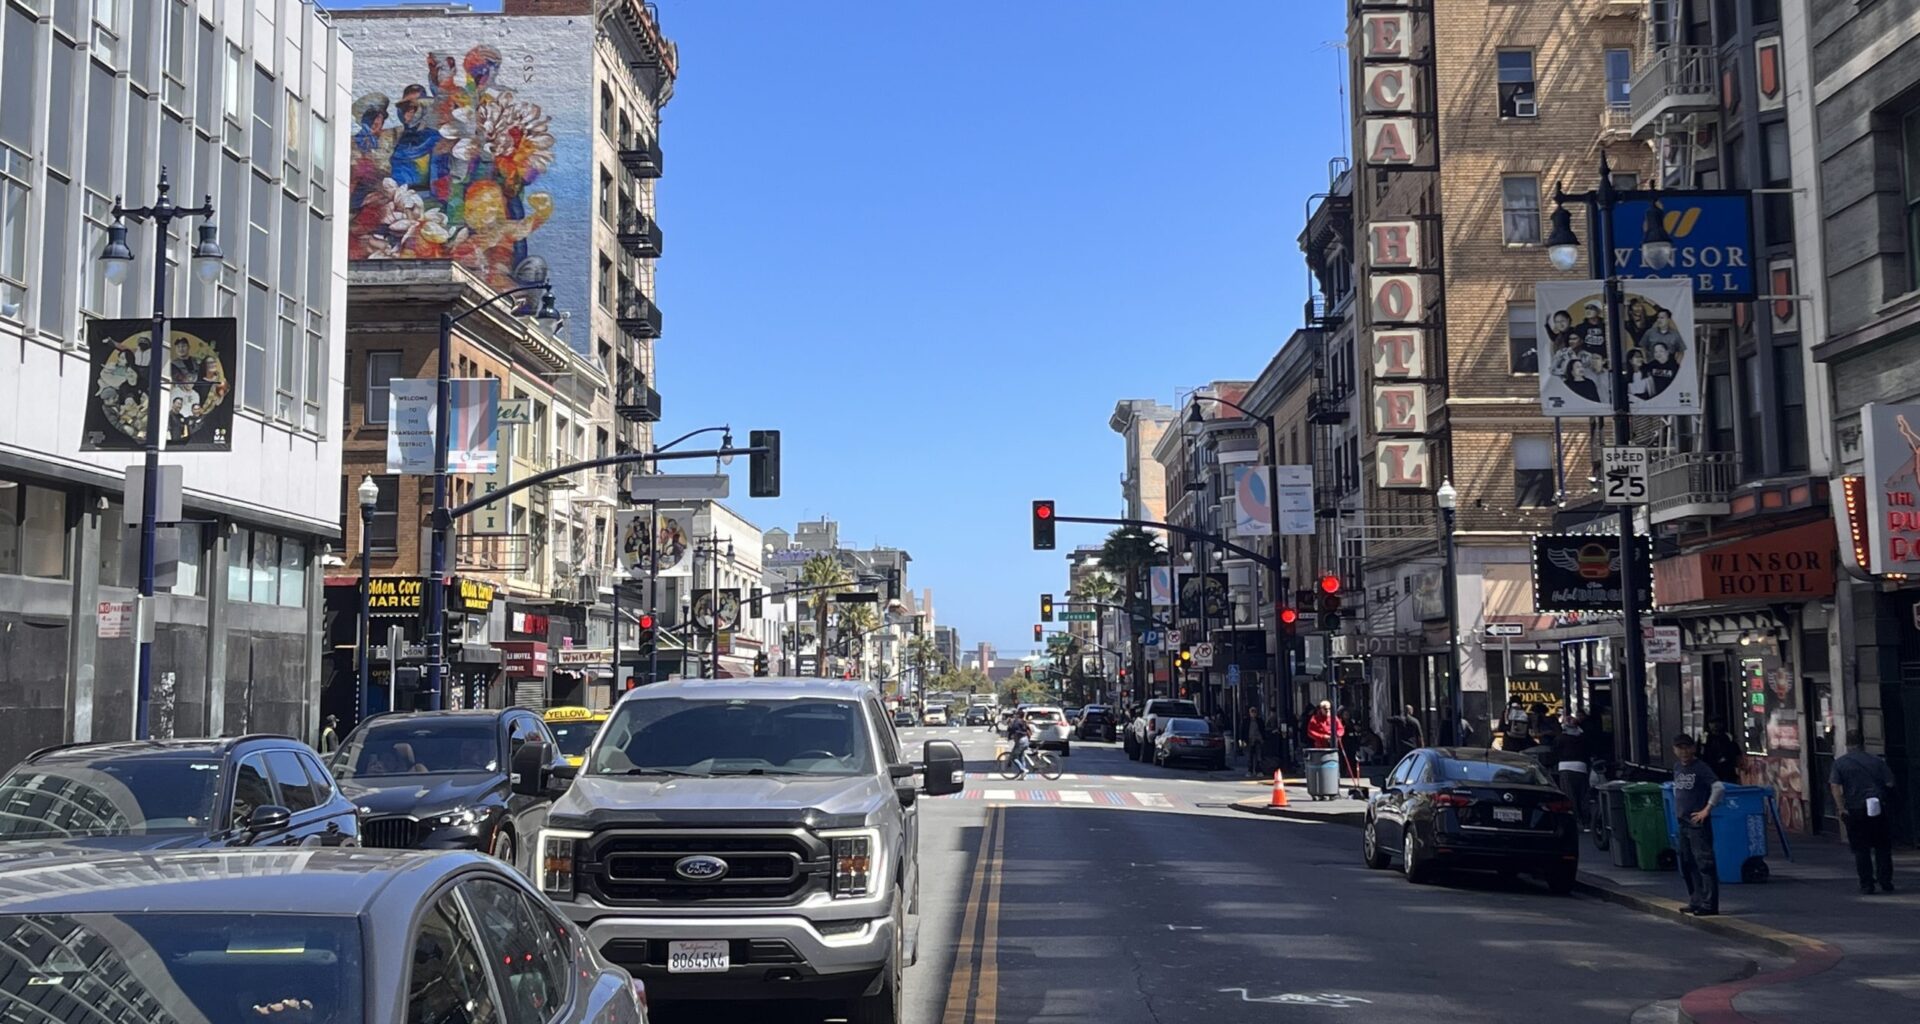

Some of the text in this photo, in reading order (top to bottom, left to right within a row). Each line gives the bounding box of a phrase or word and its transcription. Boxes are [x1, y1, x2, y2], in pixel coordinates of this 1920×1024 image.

[1373, 225, 1423, 484] HOTEL
[1606, 453, 1644, 462] SPEED
[1610, 464, 1641, 474] LIMIT
[1609, 476, 1646, 497] 25
[1707, 552, 1821, 573] WINSOR
[367, 579, 396, 596] olden
[1719, 574, 1814, 595] HOTEL
[1356, 637, 1416, 653] HOTEL
[1508, 681, 1542, 692] HALAL
[548, 710, 587, 721] YELLOW
[686, 861, 713, 874] Ford
[672, 952, 725, 969] 80645K4
